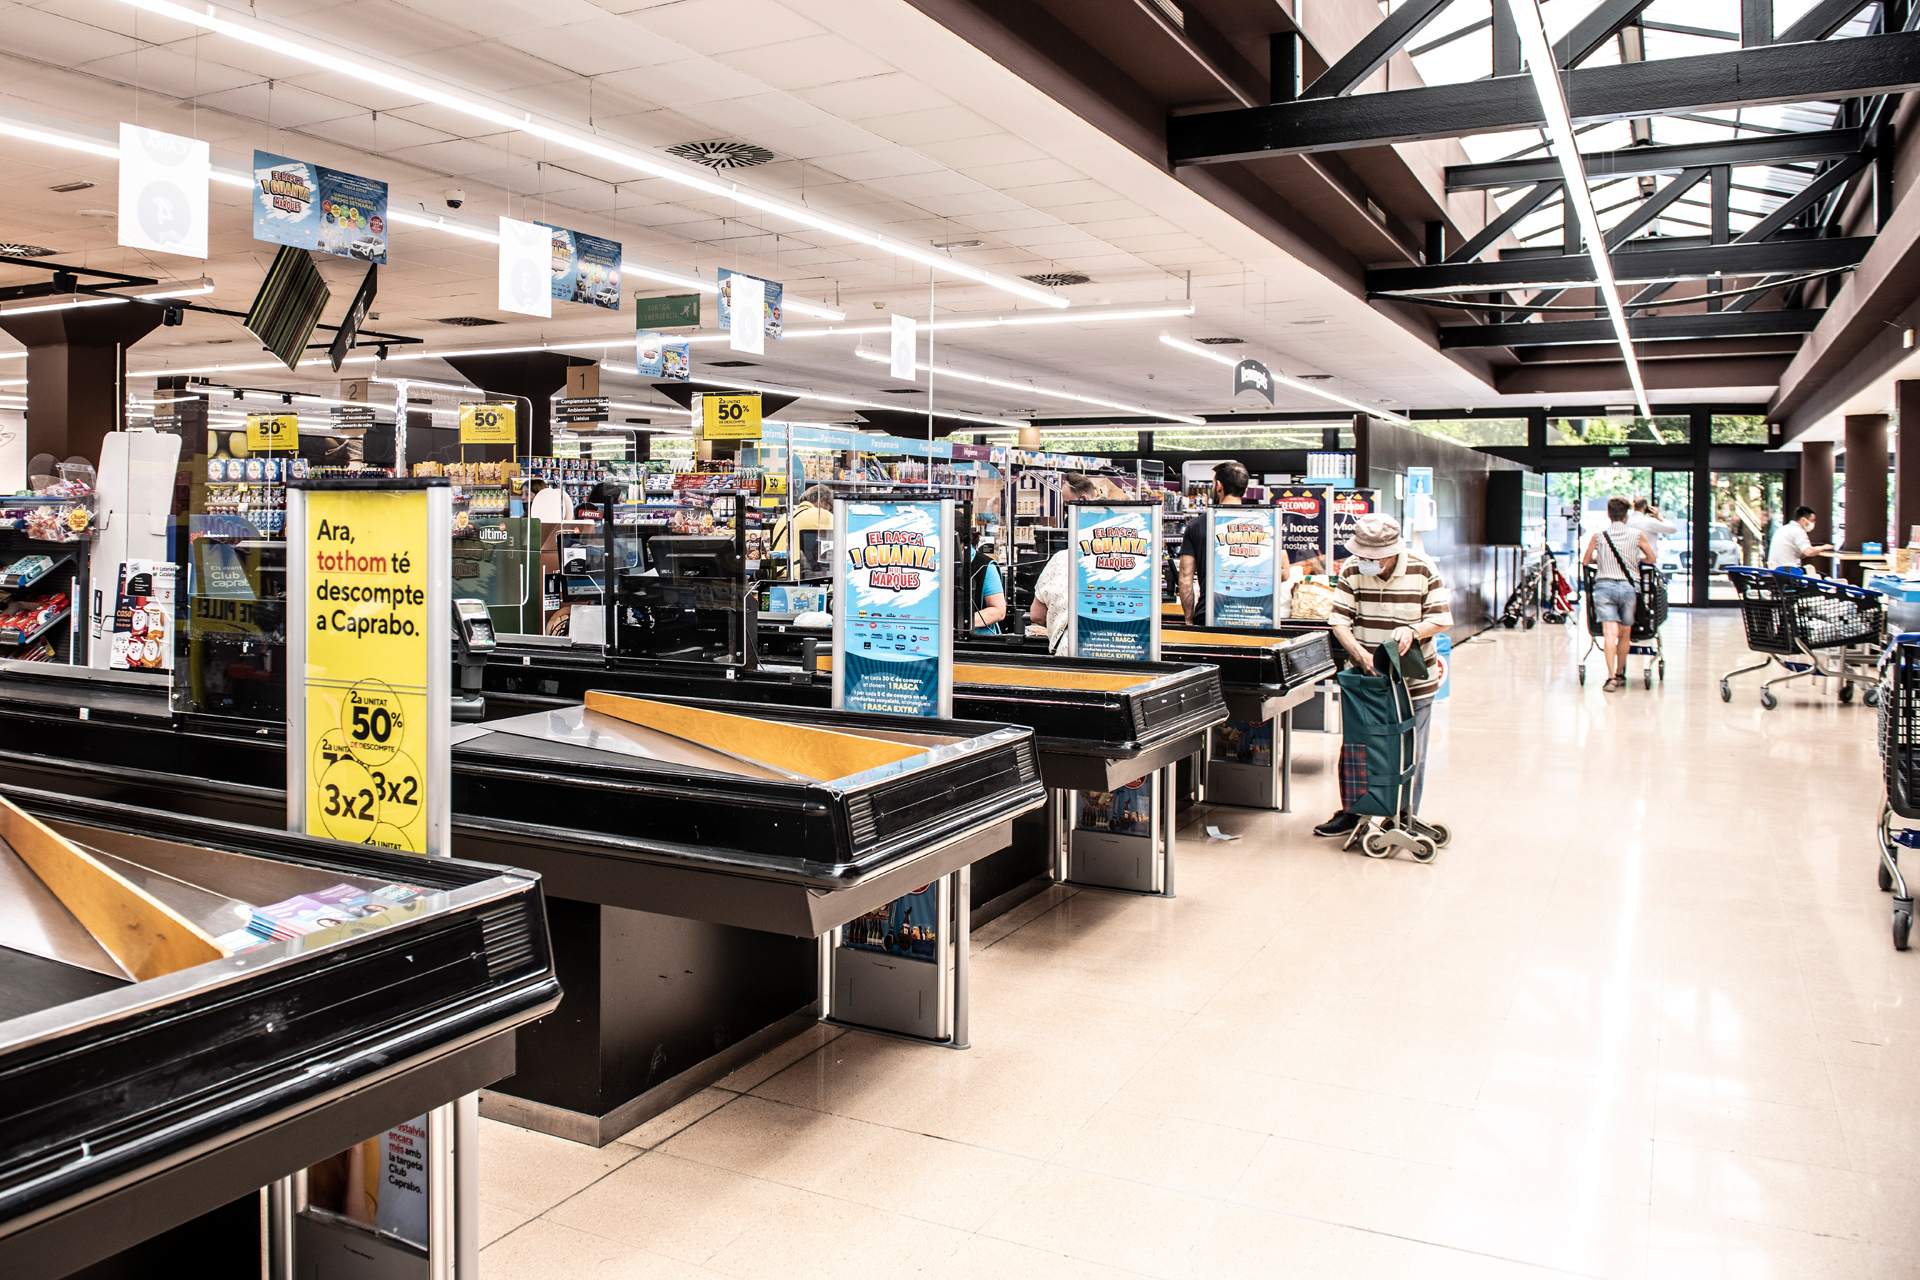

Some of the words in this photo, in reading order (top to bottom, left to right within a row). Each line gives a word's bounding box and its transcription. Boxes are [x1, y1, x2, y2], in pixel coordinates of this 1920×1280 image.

[281, 172, 304, 186] RASCA
[270, 181, 310, 202] GUANYA
[274, 197, 302, 212] MARQUES
[647, 304, 670, 312] SORTIDA
[580, 373, 585, 390] 1
[349, 384, 358, 400] 2
[718, 404, 749, 420] 50%
[475, 413, 504, 426] 50%
[259, 422, 286, 434] 50%
[762, 430, 784, 438] arafarmà
[821, 434, 850, 445] Parafarmàcia
[871, 439, 899, 449] Parafarmàcia
[964, 448, 978, 457] Higiene
[1279, 502, 1316, 510] RECONDO
[1334, 503, 1365, 511] RECONDO
[317, 519, 355, 544] Ara,
[479, 525, 507, 540] ultima
[1095, 529, 1104, 538] EL
[1107, 528, 1137, 538] RASCA
[1229, 524, 1237, 532] EL
[1290, 523, 1319, 533] hores
[1342, 523, 1356, 531] hor
[868, 532, 882, 545] EL
[884, 532, 923, 546] RASCA
[1227, 532, 1270, 546] GUANYA
[1093, 538, 1147, 555] GUANYA
[1231, 547, 1261, 557] MARQUES
[317, 550, 386, 572] tothom
[391, 551, 410, 573] té
[865, 545, 935, 570] GUANYA
[1098, 557, 1135, 570] MARQUES
[871, 571, 920, 590] MARQUES
[317, 579, 424, 610] descompte
[317, 615, 326, 630] a
[332, 609, 419, 639] Caprabo.
[893, 683, 919, 691] RASCA
[351, 691, 362, 704] 2a
[364, 698, 387, 706] UNITAT
[868, 704, 892, 712] RASCA
[894, 706, 918, 714] EXTRA
[352, 706, 403, 742] 50%
[322, 739, 332, 750] 2a
[359, 742, 395, 753] DESCOMPTE
[372, 772, 418, 806] 3x2
[324, 784, 374, 821] 3x2
[389, 1132, 413, 1145] encara
[389, 1142, 404, 1154] més
[405, 1148, 421, 1159] amb
[389, 1152, 395, 1161] la
[396, 1155, 423, 1171] targeta
[389, 1164, 406, 1177] Club
[389, 1175, 422, 1194] Caprabo.
